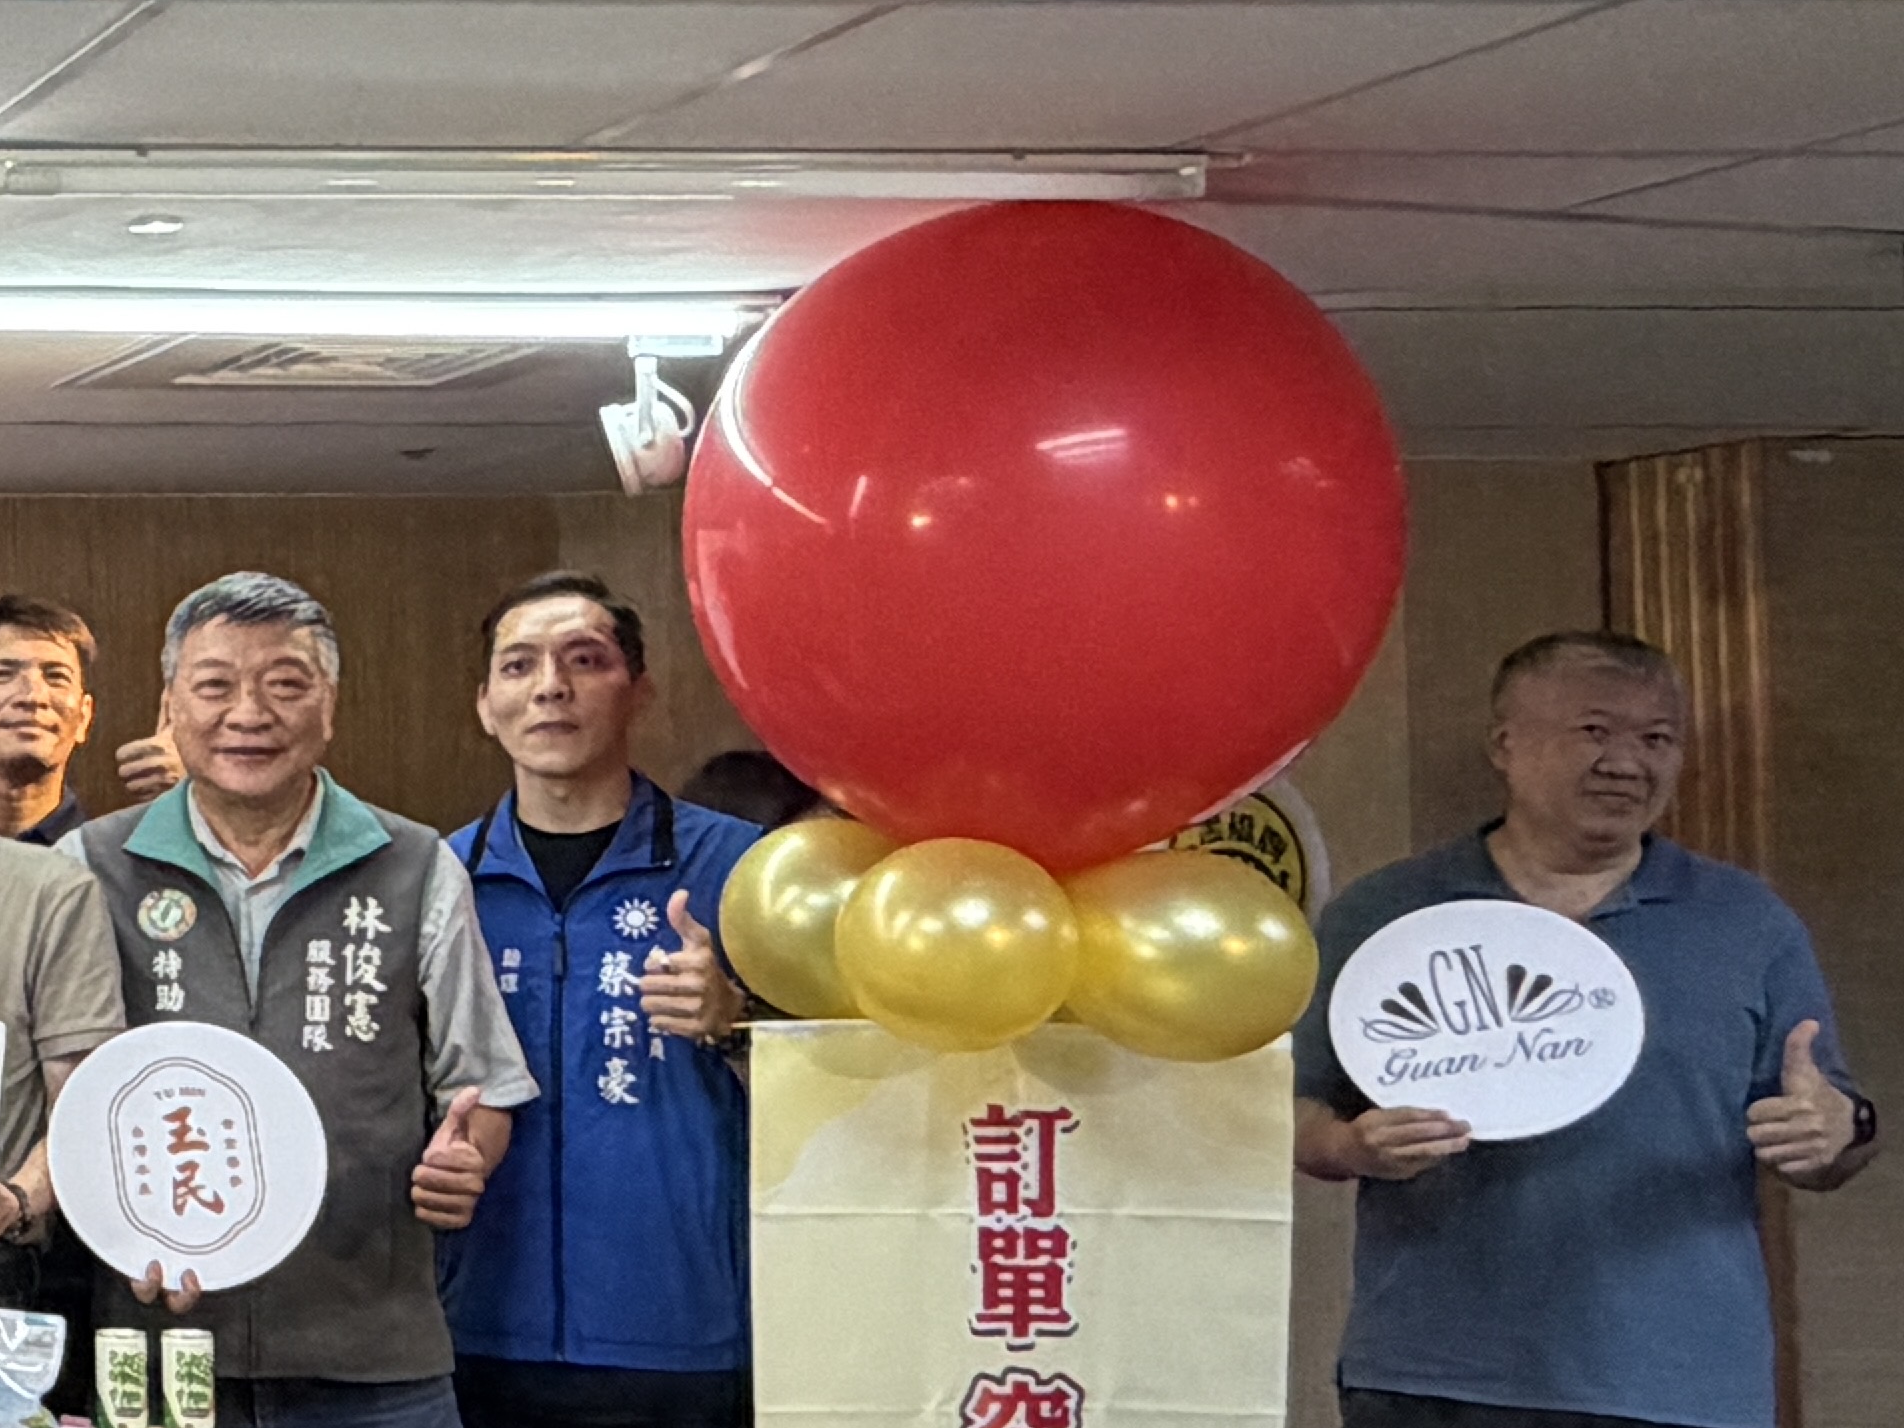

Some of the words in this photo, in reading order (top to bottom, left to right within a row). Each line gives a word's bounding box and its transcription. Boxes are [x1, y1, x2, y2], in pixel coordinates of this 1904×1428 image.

[341, 895, 392, 1042] 林俊憲
[1427, 944, 1498, 1037] GN
[597, 950, 641, 1105] 蔡宗豪
[1376, 1046, 1486, 1088] Guan
[1496, 1027, 1594, 1070] Nan
[162, 1105, 225, 1216] 玉民
